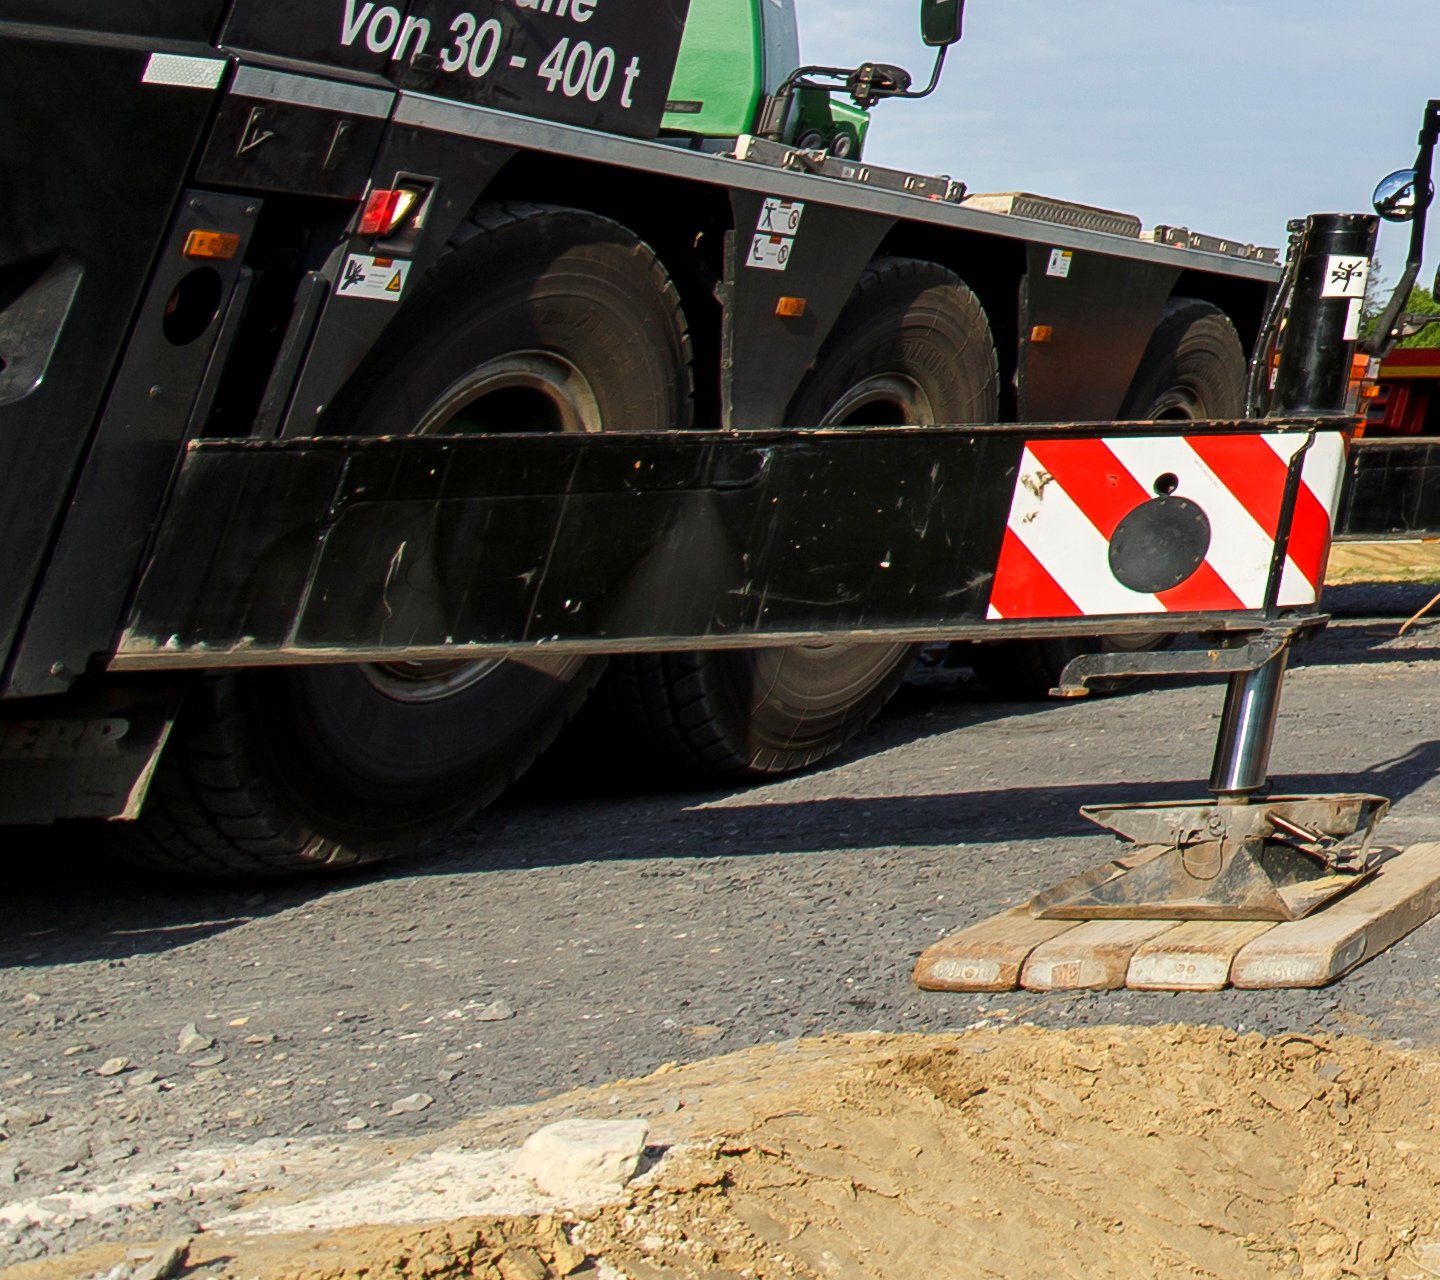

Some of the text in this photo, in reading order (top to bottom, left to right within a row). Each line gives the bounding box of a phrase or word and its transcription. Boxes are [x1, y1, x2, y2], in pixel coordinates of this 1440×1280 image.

[440, 12, 501, 78] 30
[538, 37, 615, 102] 400
[621, 56, 640, 109] t
